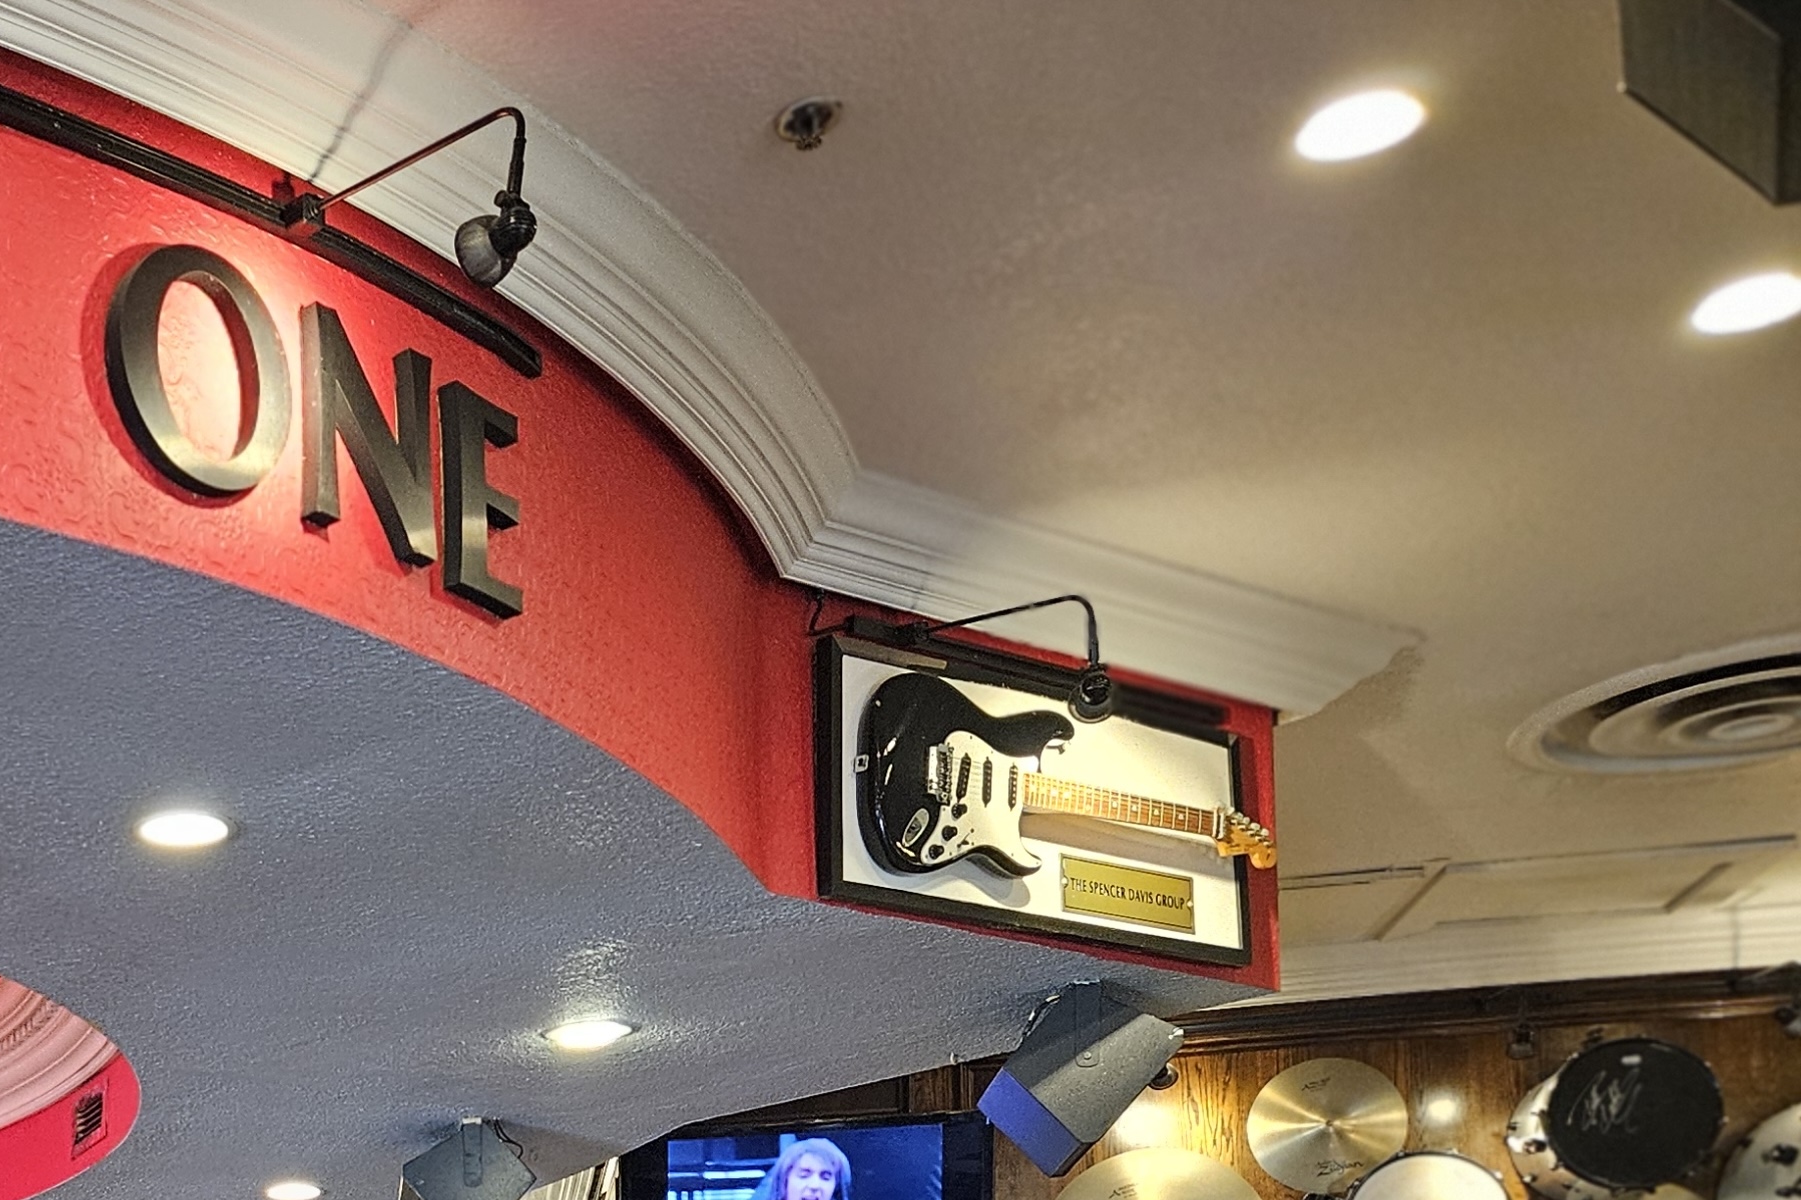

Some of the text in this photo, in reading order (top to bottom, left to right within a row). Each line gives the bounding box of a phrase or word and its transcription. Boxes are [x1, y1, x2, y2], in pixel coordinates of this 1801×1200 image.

[105, 244, 524, 620] ONE
[1070, 877, 1185, 911] THE SPENCER DAVIS GROUP
